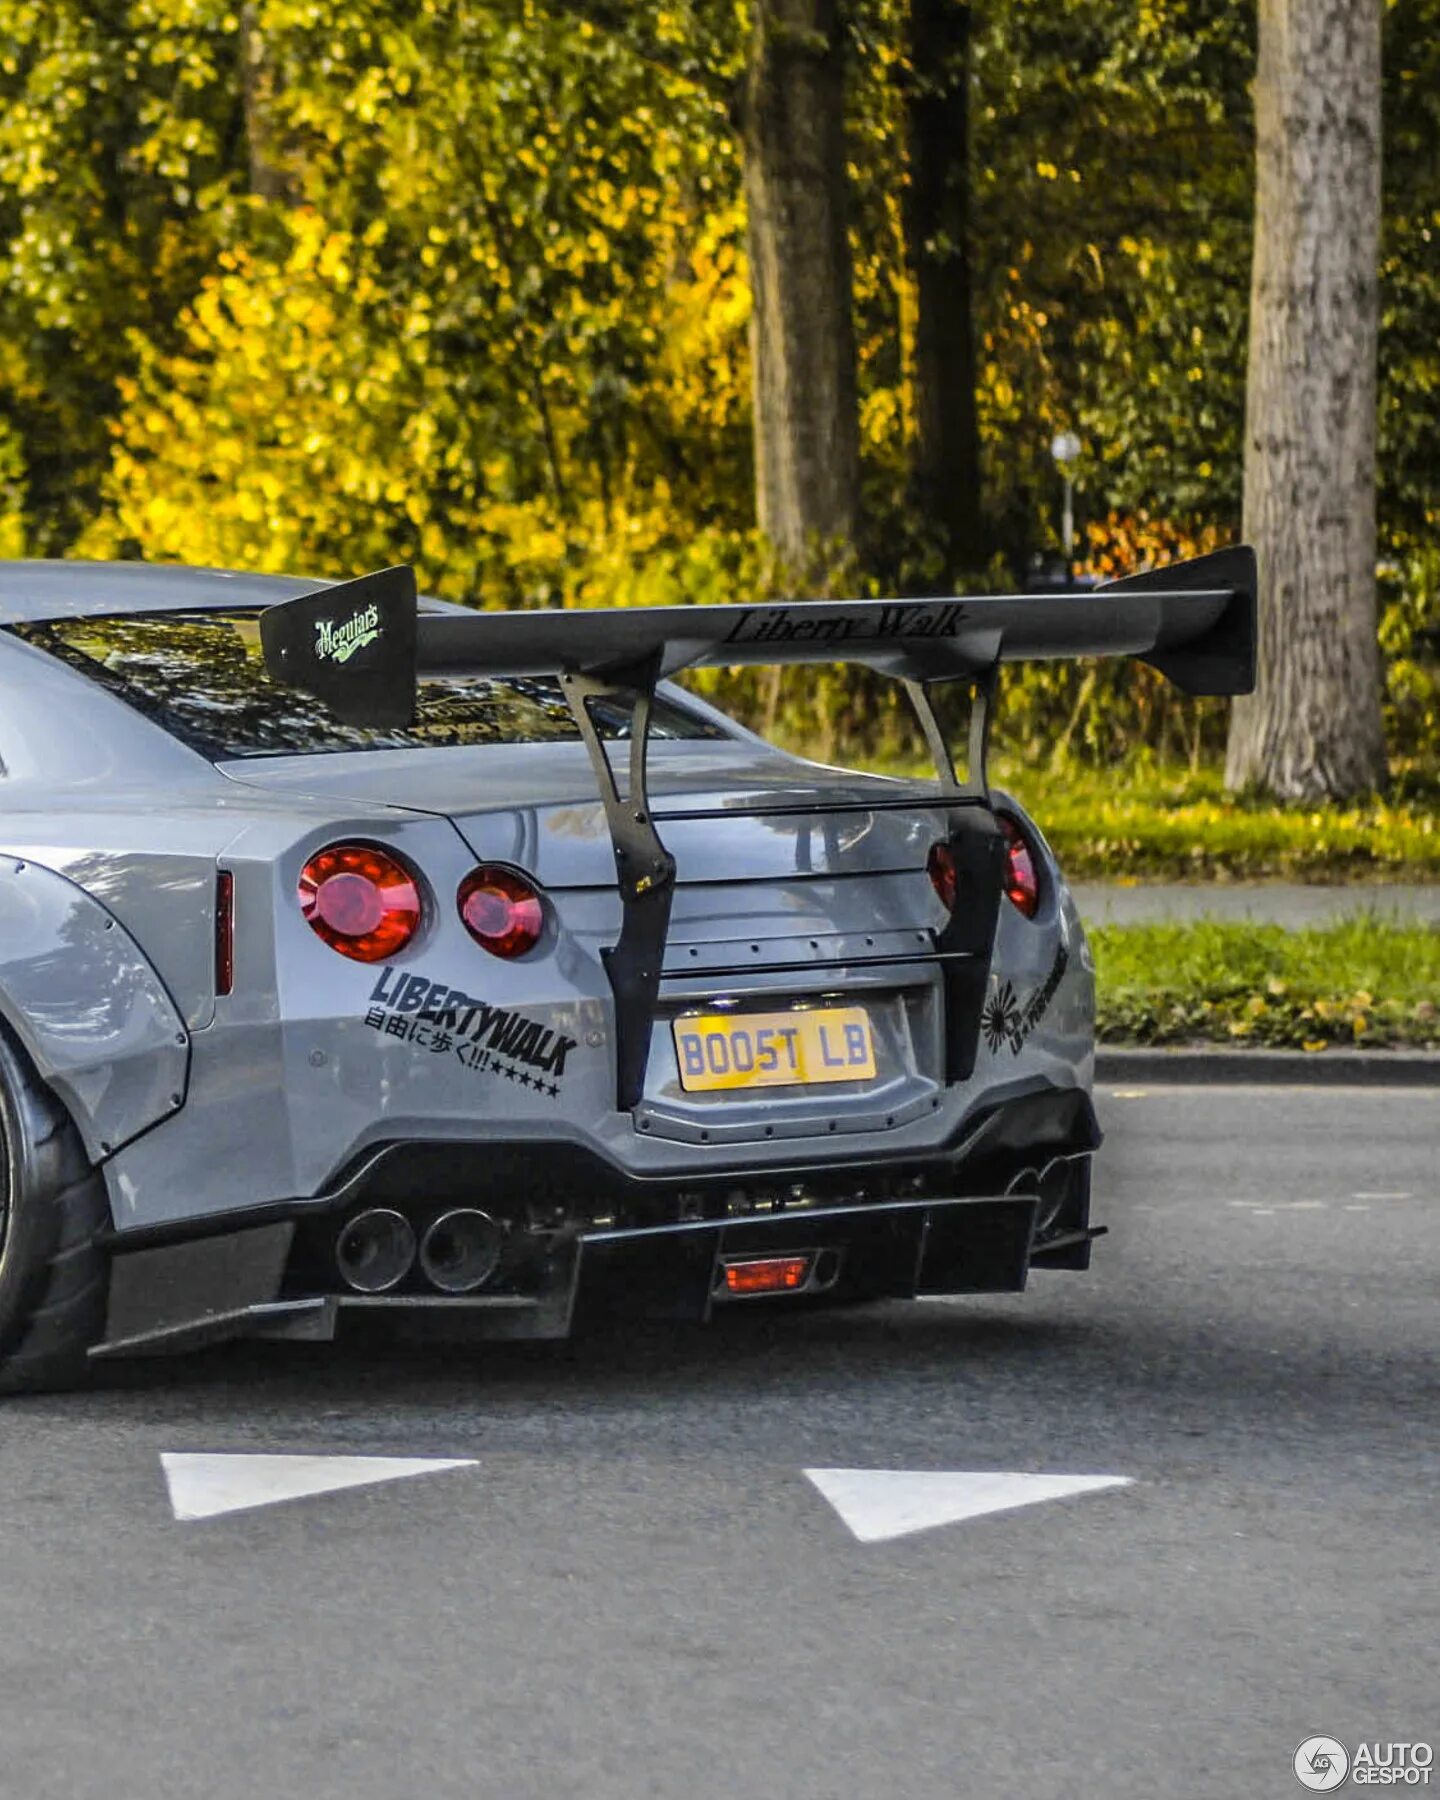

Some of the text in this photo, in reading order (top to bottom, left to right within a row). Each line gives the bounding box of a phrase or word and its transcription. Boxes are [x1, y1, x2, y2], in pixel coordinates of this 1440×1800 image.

[315, 603, 379, 660] Meguiar's
[877, 604, 971, 638] Walk
[369, 965, 578, 1077] LIBERTYWALK
[818, 1023, 868, 1067] LB
